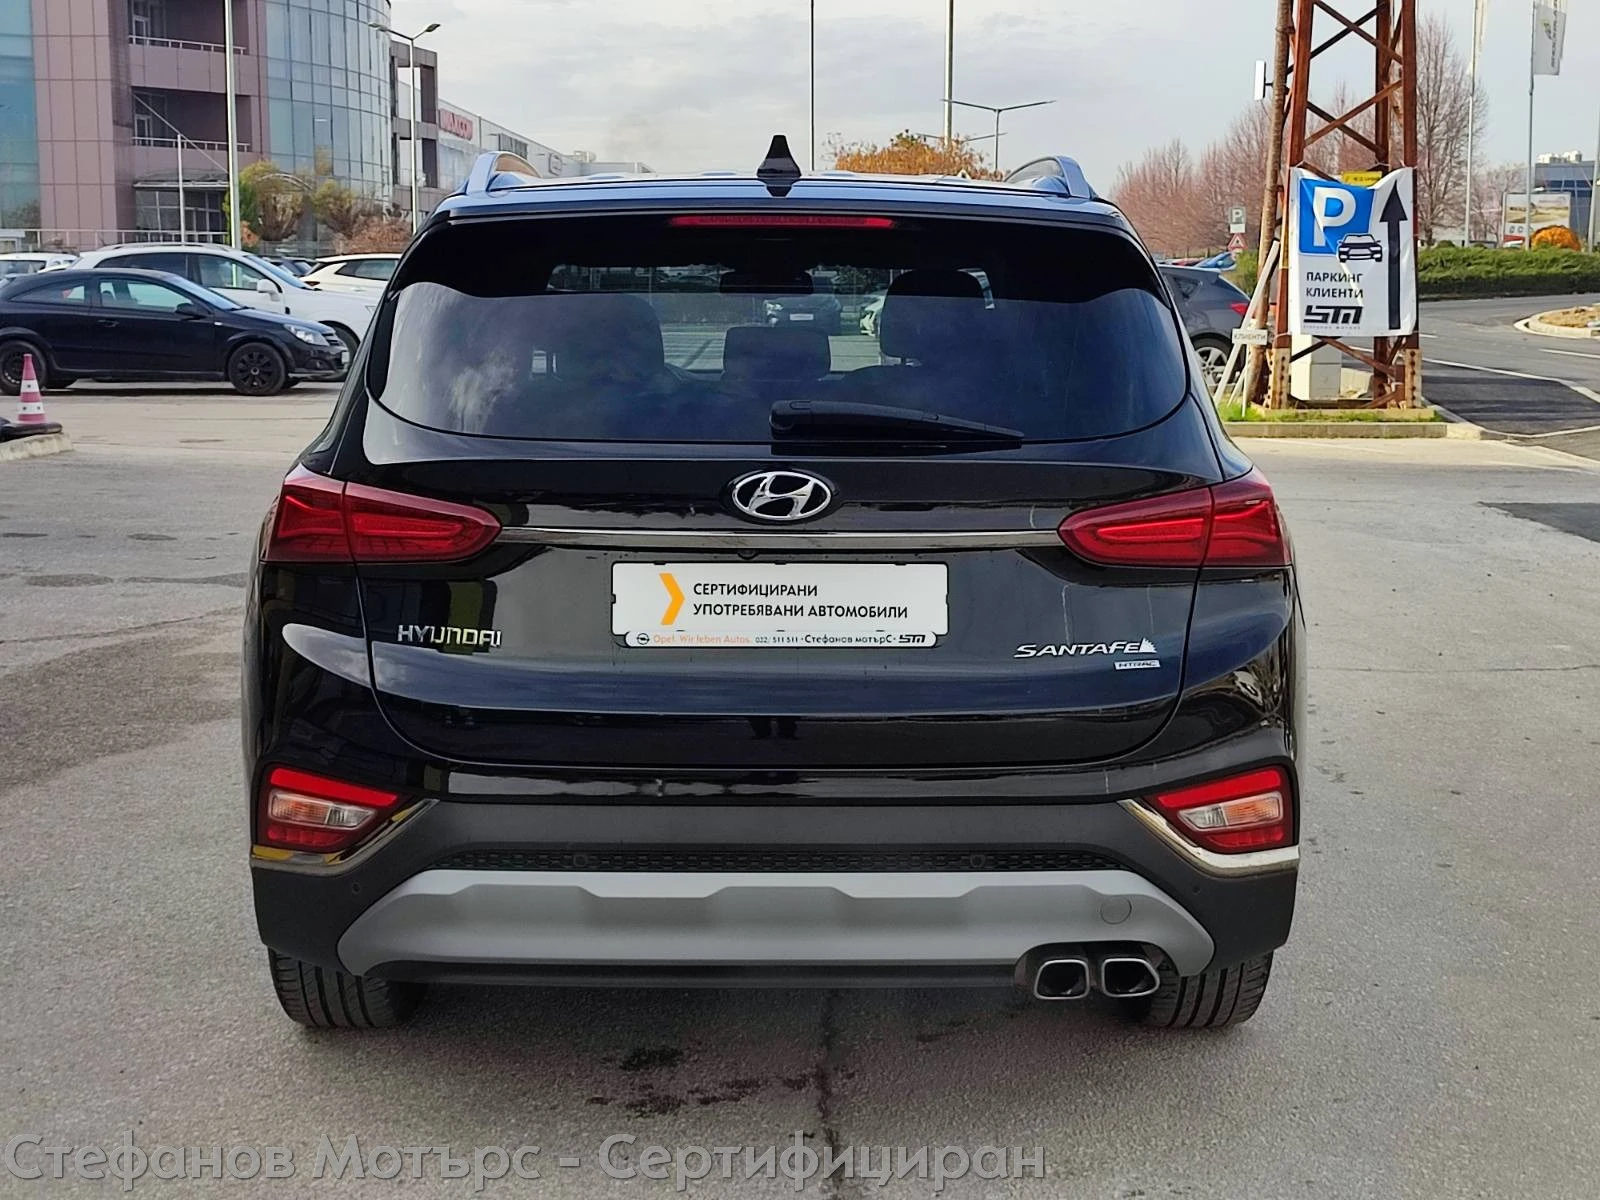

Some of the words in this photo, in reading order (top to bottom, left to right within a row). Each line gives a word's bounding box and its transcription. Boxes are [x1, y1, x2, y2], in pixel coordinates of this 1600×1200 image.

[1312, 186, 1357, 247] P
[1306, 271, 1364, 283] ПАРКИНГ
[1306, 287, 1364, 299] КЛИЕНТИ
[693, 583, 818, 598] СЕРТИФИЦИРАНИ
[693, 603, 804, 617] УПОТРЕБЯВАНИ
[808, 605, 908, 619] АВТОМОБИЛИ
[397, 624, 502, 646] HYUNDAI
